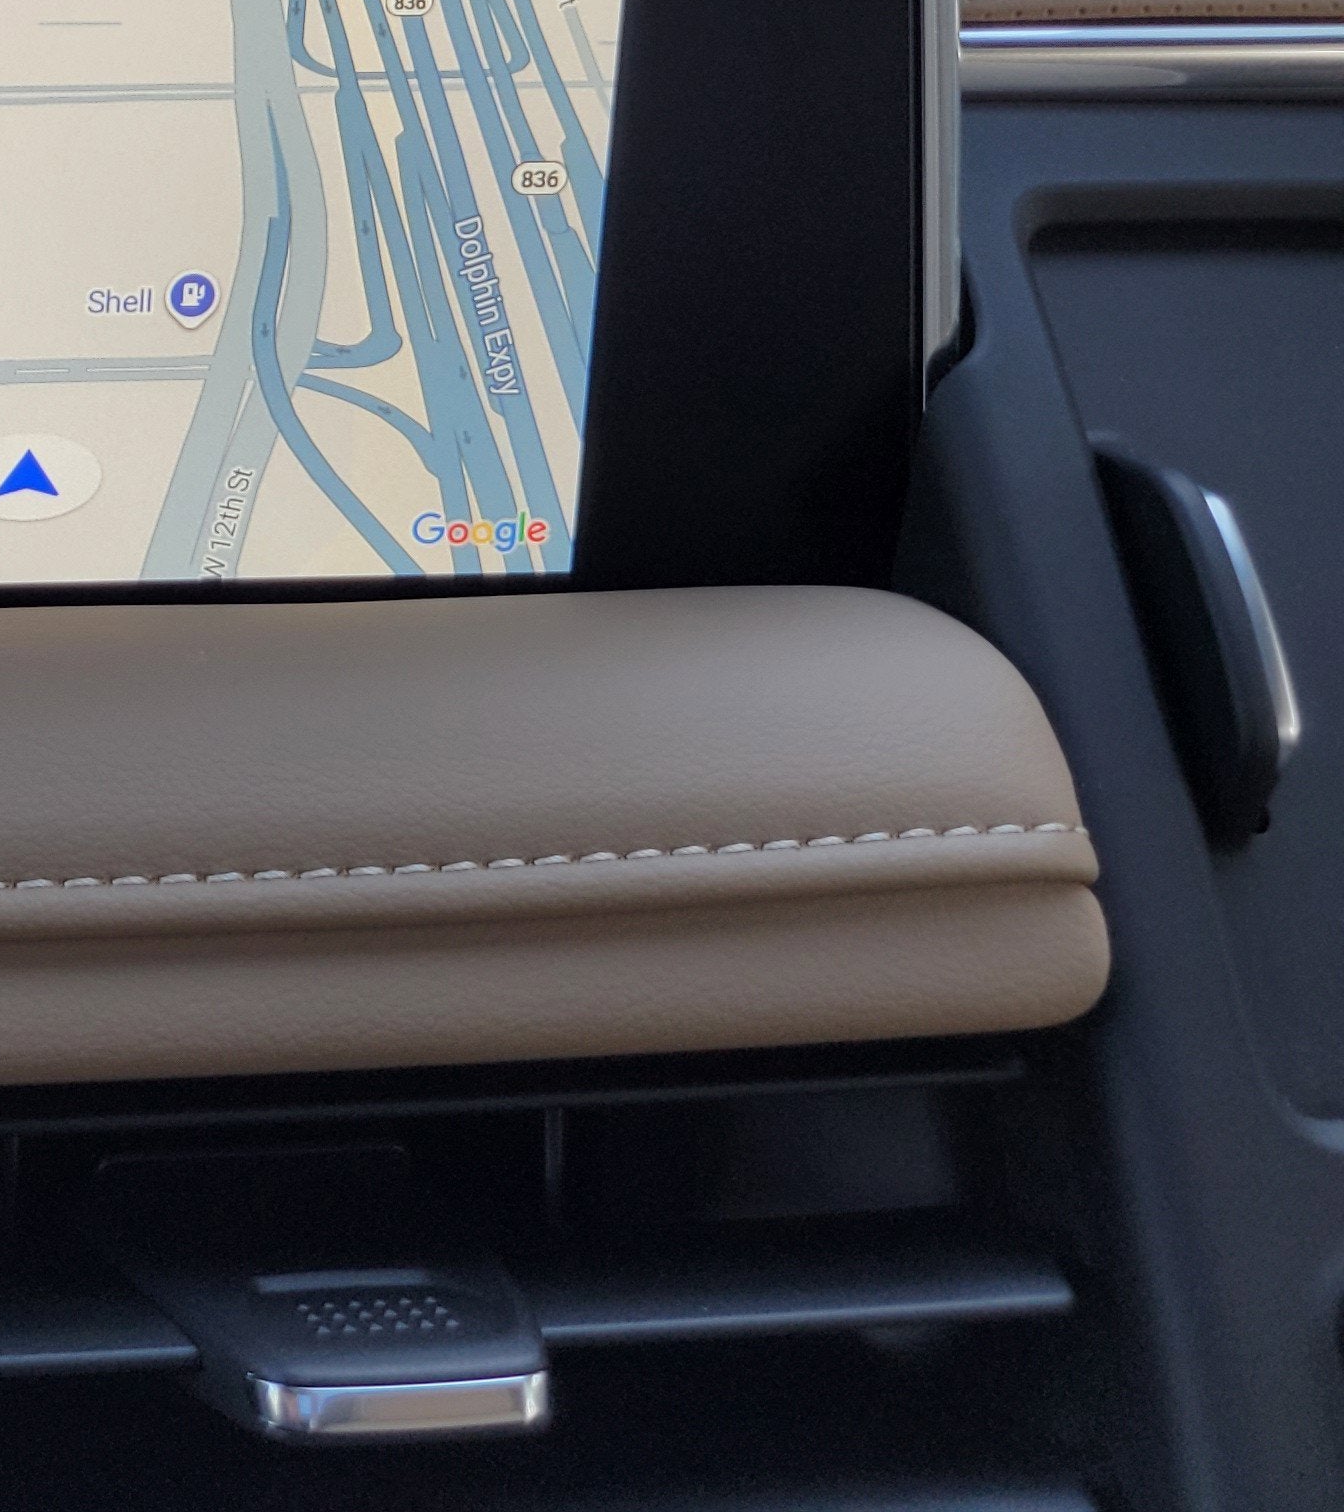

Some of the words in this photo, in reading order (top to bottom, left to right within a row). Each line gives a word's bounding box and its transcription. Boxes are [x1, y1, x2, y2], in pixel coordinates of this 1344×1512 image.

[521, 171, 559, 188] 836
[87, 288, 153, 315] Shell
[454, 214, 505, 326] Dolphin
[484, 327, 520, 396] Expy
[211, 497, 244, 549] 12th
[228, 468, 253, 492] St
[413, 511, 548, 553] Google
